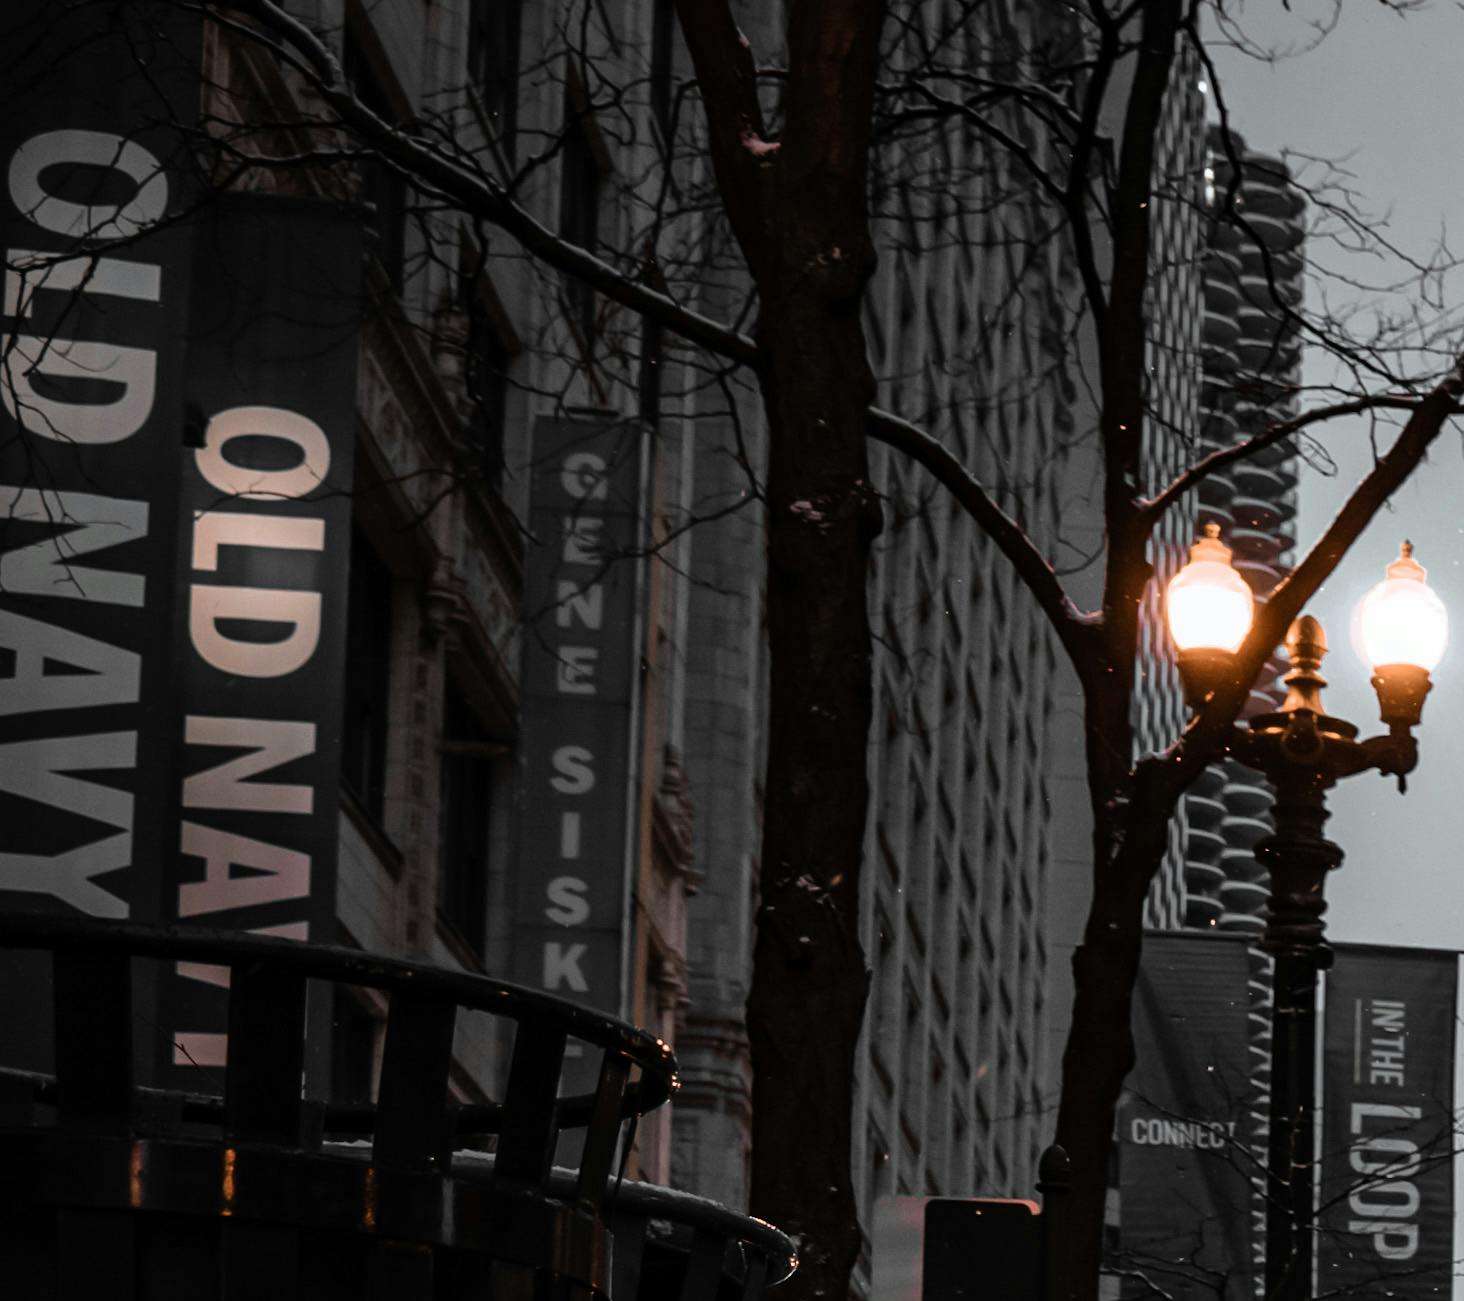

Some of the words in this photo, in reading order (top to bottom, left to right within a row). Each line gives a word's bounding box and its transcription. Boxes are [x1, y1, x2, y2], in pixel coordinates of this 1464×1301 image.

[4, 127, 170, 445] OLD
[188, 405, 332, 678] OLD
[555, 453, 607, 694] GENE
[0, 485, 150, 920] NAVY
[1131, 1117, 1236, 1150] CONNECT
[1348, 1102, 1422, 1261] LOOP
[1369, 1036, 1405, 1088] THE
